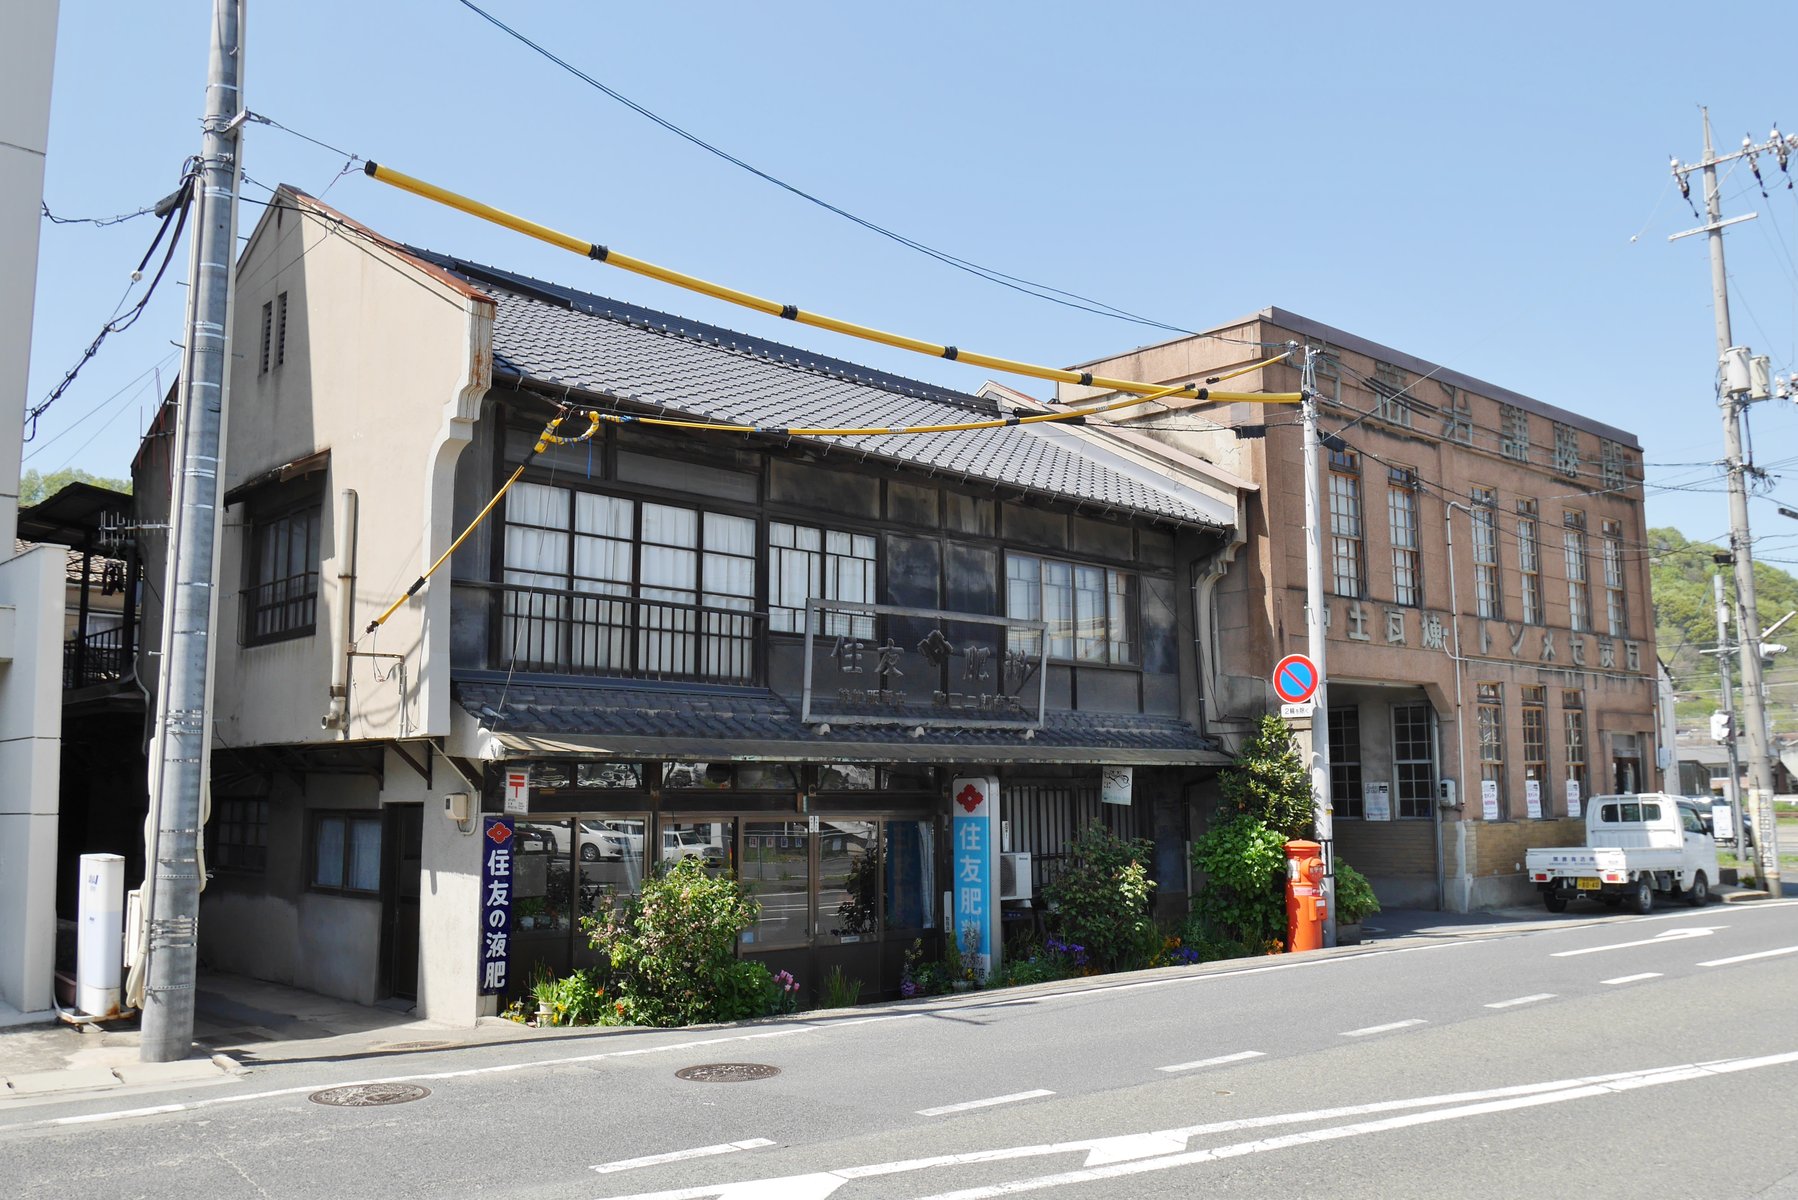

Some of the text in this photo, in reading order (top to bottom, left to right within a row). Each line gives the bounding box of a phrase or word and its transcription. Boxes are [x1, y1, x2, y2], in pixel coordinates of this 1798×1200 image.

[831, 634, 905, 677] 住友
[483, 849, 510, 990] 住友の液肥
